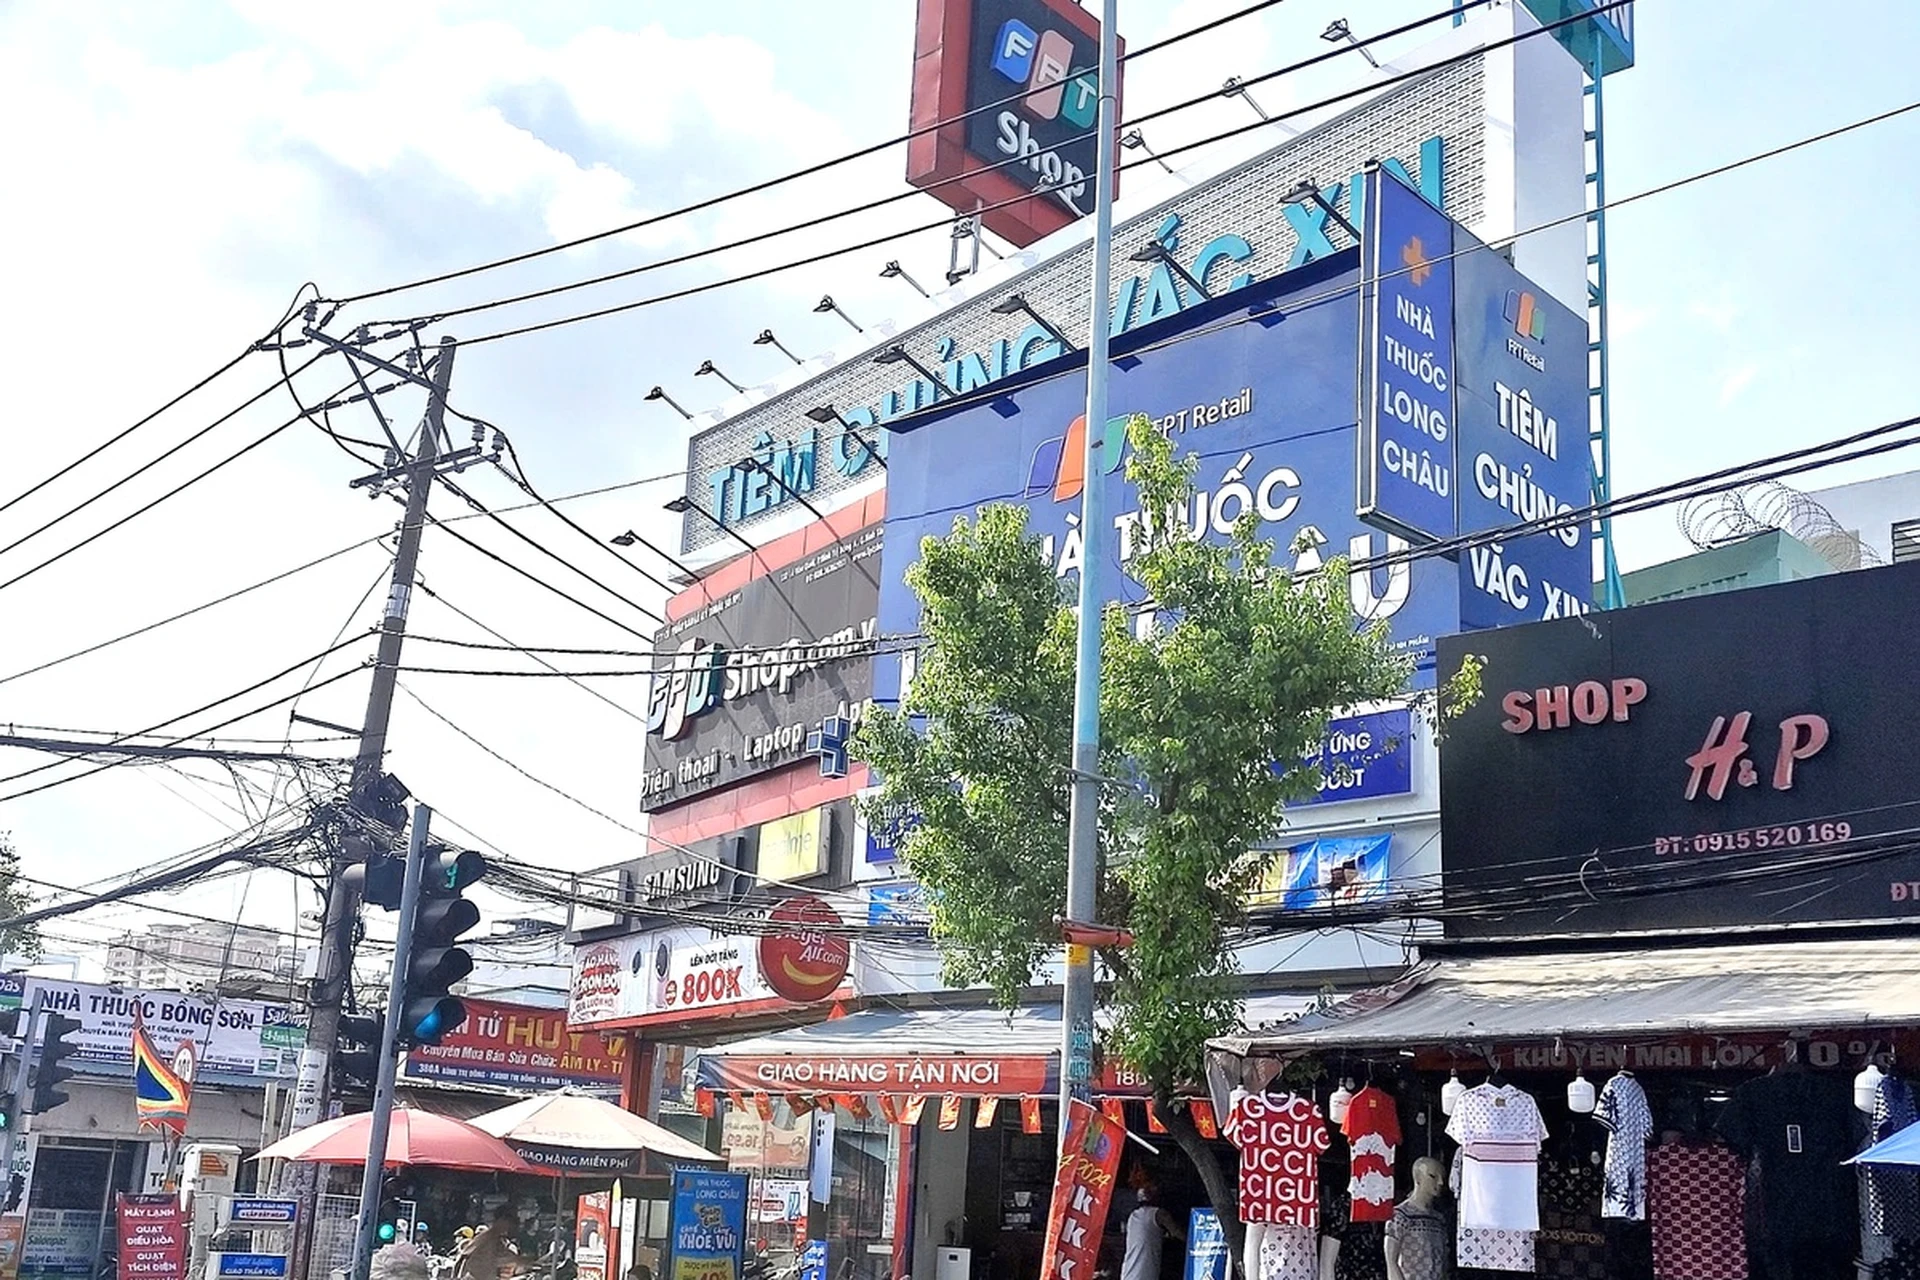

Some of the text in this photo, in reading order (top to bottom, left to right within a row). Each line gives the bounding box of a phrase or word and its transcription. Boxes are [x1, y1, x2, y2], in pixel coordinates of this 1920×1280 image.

[996, 110, 1086, 200] Shop
[1396, 293, 1436, 341] NHÀ
[1384, 334, 1447, 392] THUỐC
[1192, 387, 1252, 430] Retail
[1383, 381, 1448, 443] LONG
[1494, 380, 1559, 463] TIÊM
[1382, 439, 1449, 498] CHÂU
[1473, 451, 1581, 549] CHỦNG
[1501, 676, 1648, 734] SHOP
[744, 722, 806, 763] Laptop
[1684, 710, 1752, 801] H
[1772, 713, 1830, 791] P
[1694, 832, 1750, 853] 0915
[1755, 826, 1801, 847] 520
[1806, 821, 1852, 844] 169
[643, 860, 721, 903] SAMSUNG
[682, 965, 744, 1006] 800K
[41, 988, 254, 1031] NHÀ THUỐC BỒNG SƠN
[756, 1057, 1000, 1090] GIAO HÀNG TẬN NƠI
[545, 1153, 578, 1166] HÀNG
[609, 1157, 630, 1169] PHÍ
[124, 1207, 145, 1217] MÁY
[135, 1225, 165, 1236] QUẠT
[136, 1252, 166, 1262] QUẠT
[716, 1233, 737, 1250] VUI
